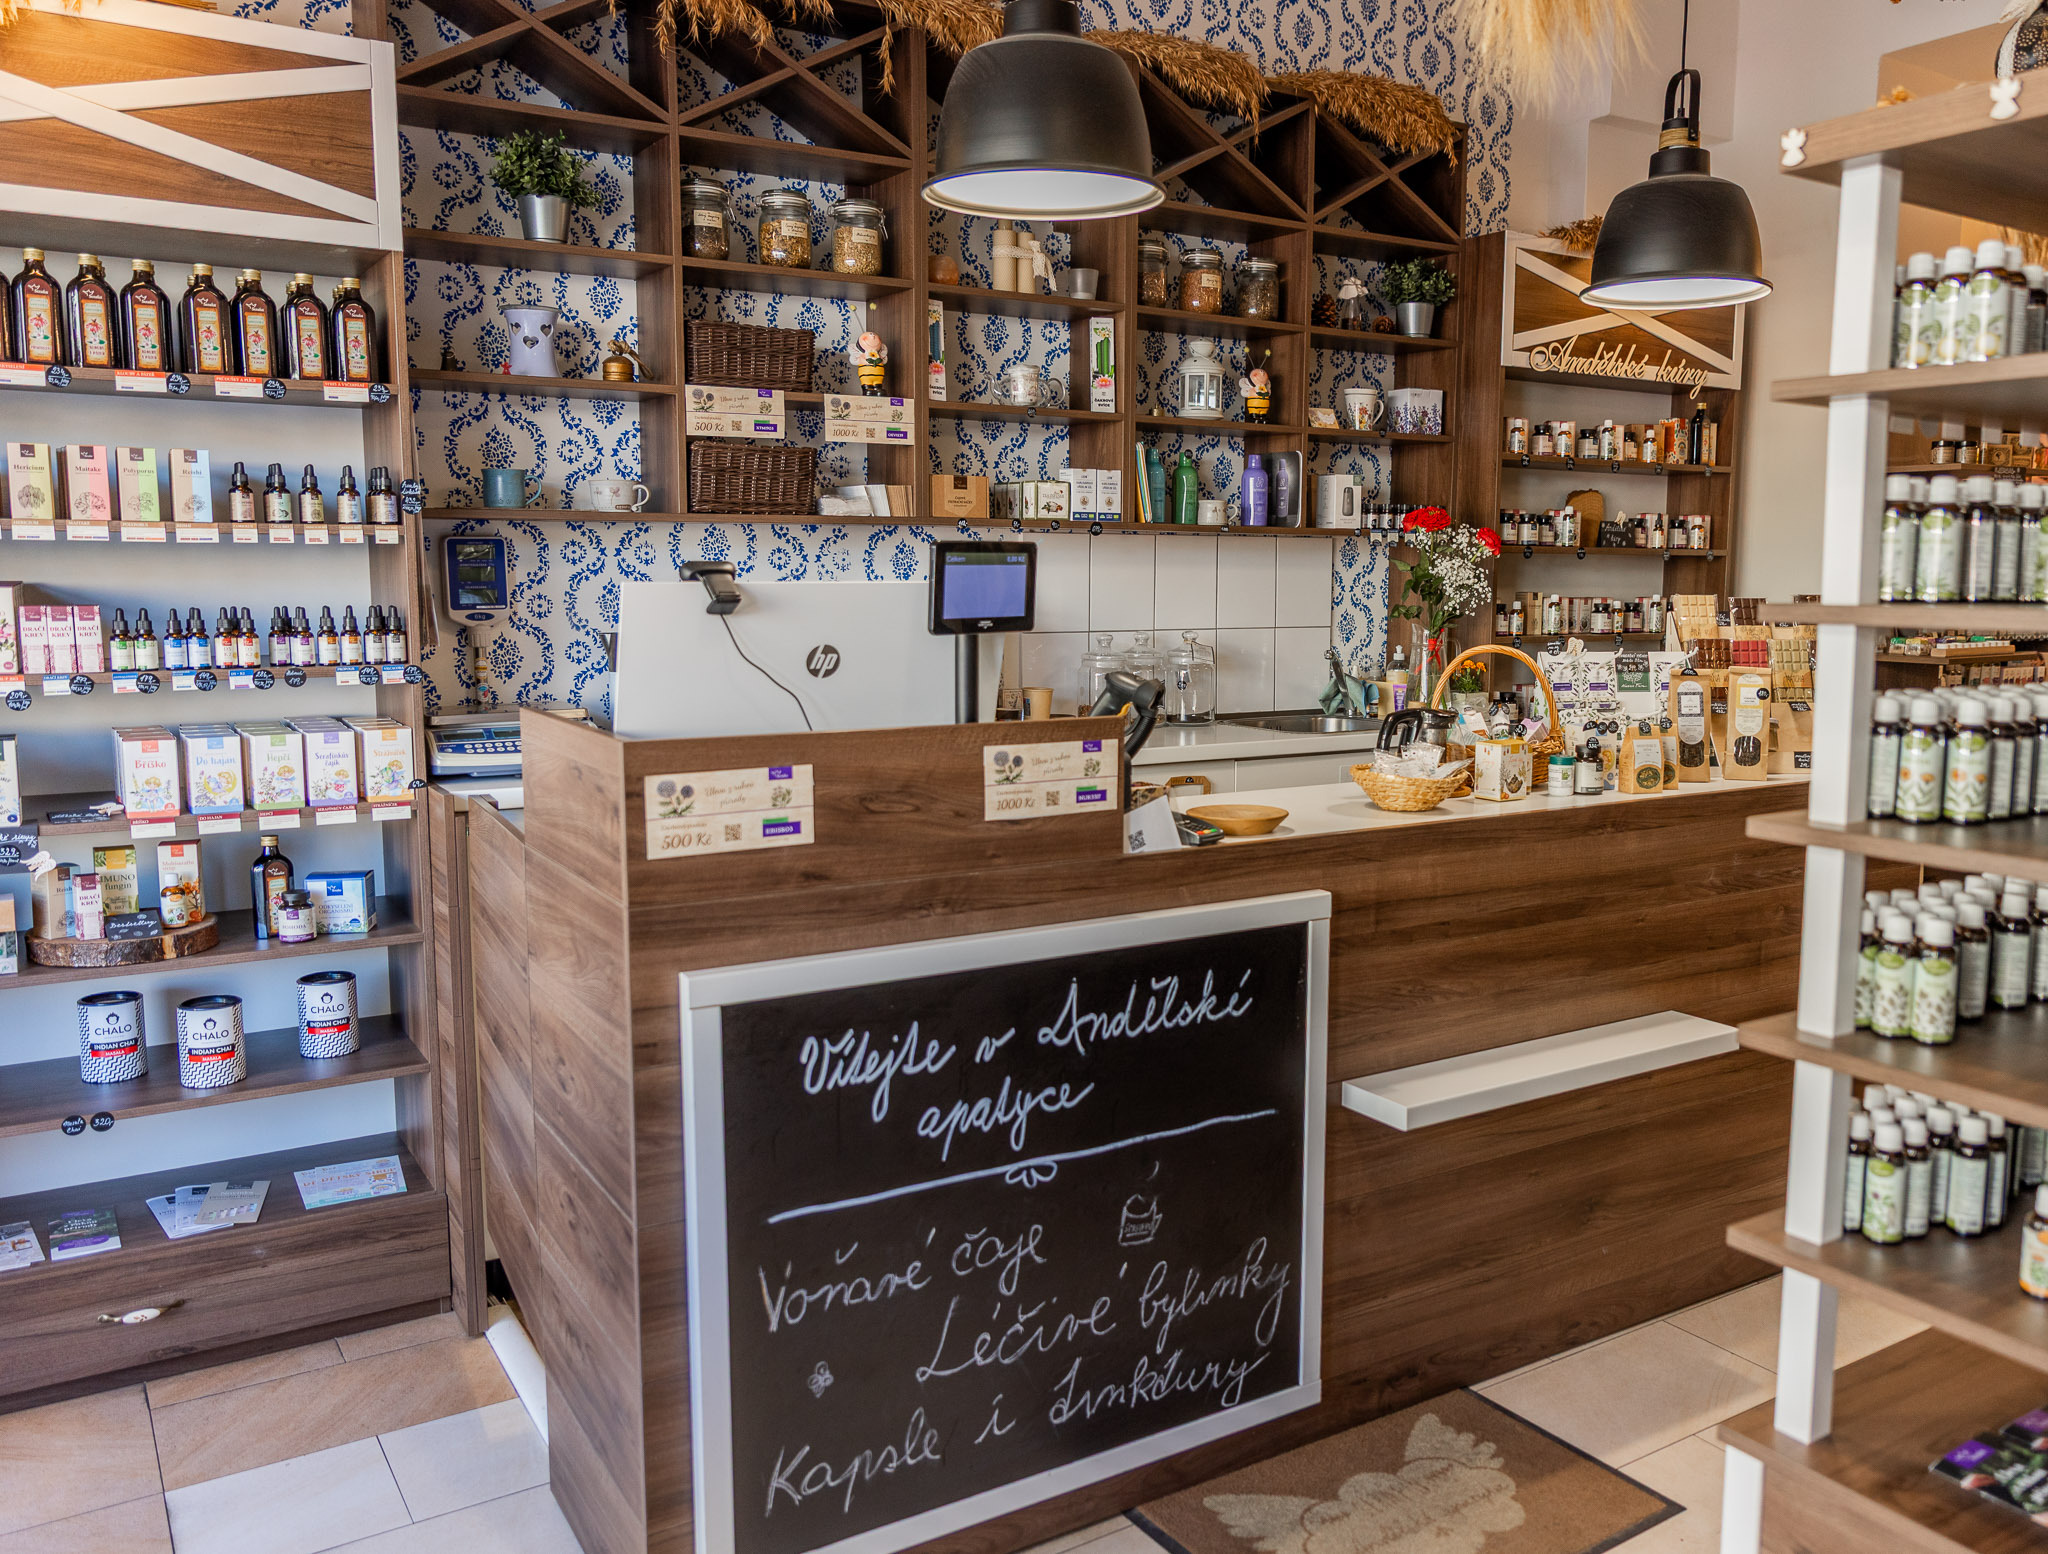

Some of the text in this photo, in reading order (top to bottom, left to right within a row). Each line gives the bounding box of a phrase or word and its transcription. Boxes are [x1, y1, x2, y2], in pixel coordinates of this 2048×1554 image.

[1529, 334, 1708, 400] Andělské kúry
[694, 421, 725, 432] 500 Kč
[832, 428, 849, 437] 1000
[123, 467, 155, 475] Polyporus
[807, 645, 840, 678] hp
[196, 757, 236, 767] Do hajan
[266, 752, 290, 763] Hepčí
[135, 760, 167, 769] Bříško
[325, 759, 340, 768] čajík
[996, 796, 1036, 811] 1000 Kč
[661, 832, 712, 850] 500 Kč
[100, 873, 135, 882] IMUNO
[105, 883, 132, 891] fungin
[310, 1003, 344, 1014] CHALO
[310, 1020, 331, 1028] INDIAN
[94, 1024, 132, 1036] CHALO
[192, 1029, 229, 1041] CHALO
[94, 1039, 135, 1051] INDIAN CHAI
[191, 1045, 232, 1056] INDIAN CHAI
[800, 968, 1254, 1123] Vítejte v Andělské
[917, 1075, 1095, 1162] apatyce
[758, 1224, 1047, 1333] Voňavé čaje
[764, 1406, 942, 1517] Kapsle
[974, 1393, 1016, 1444] i
